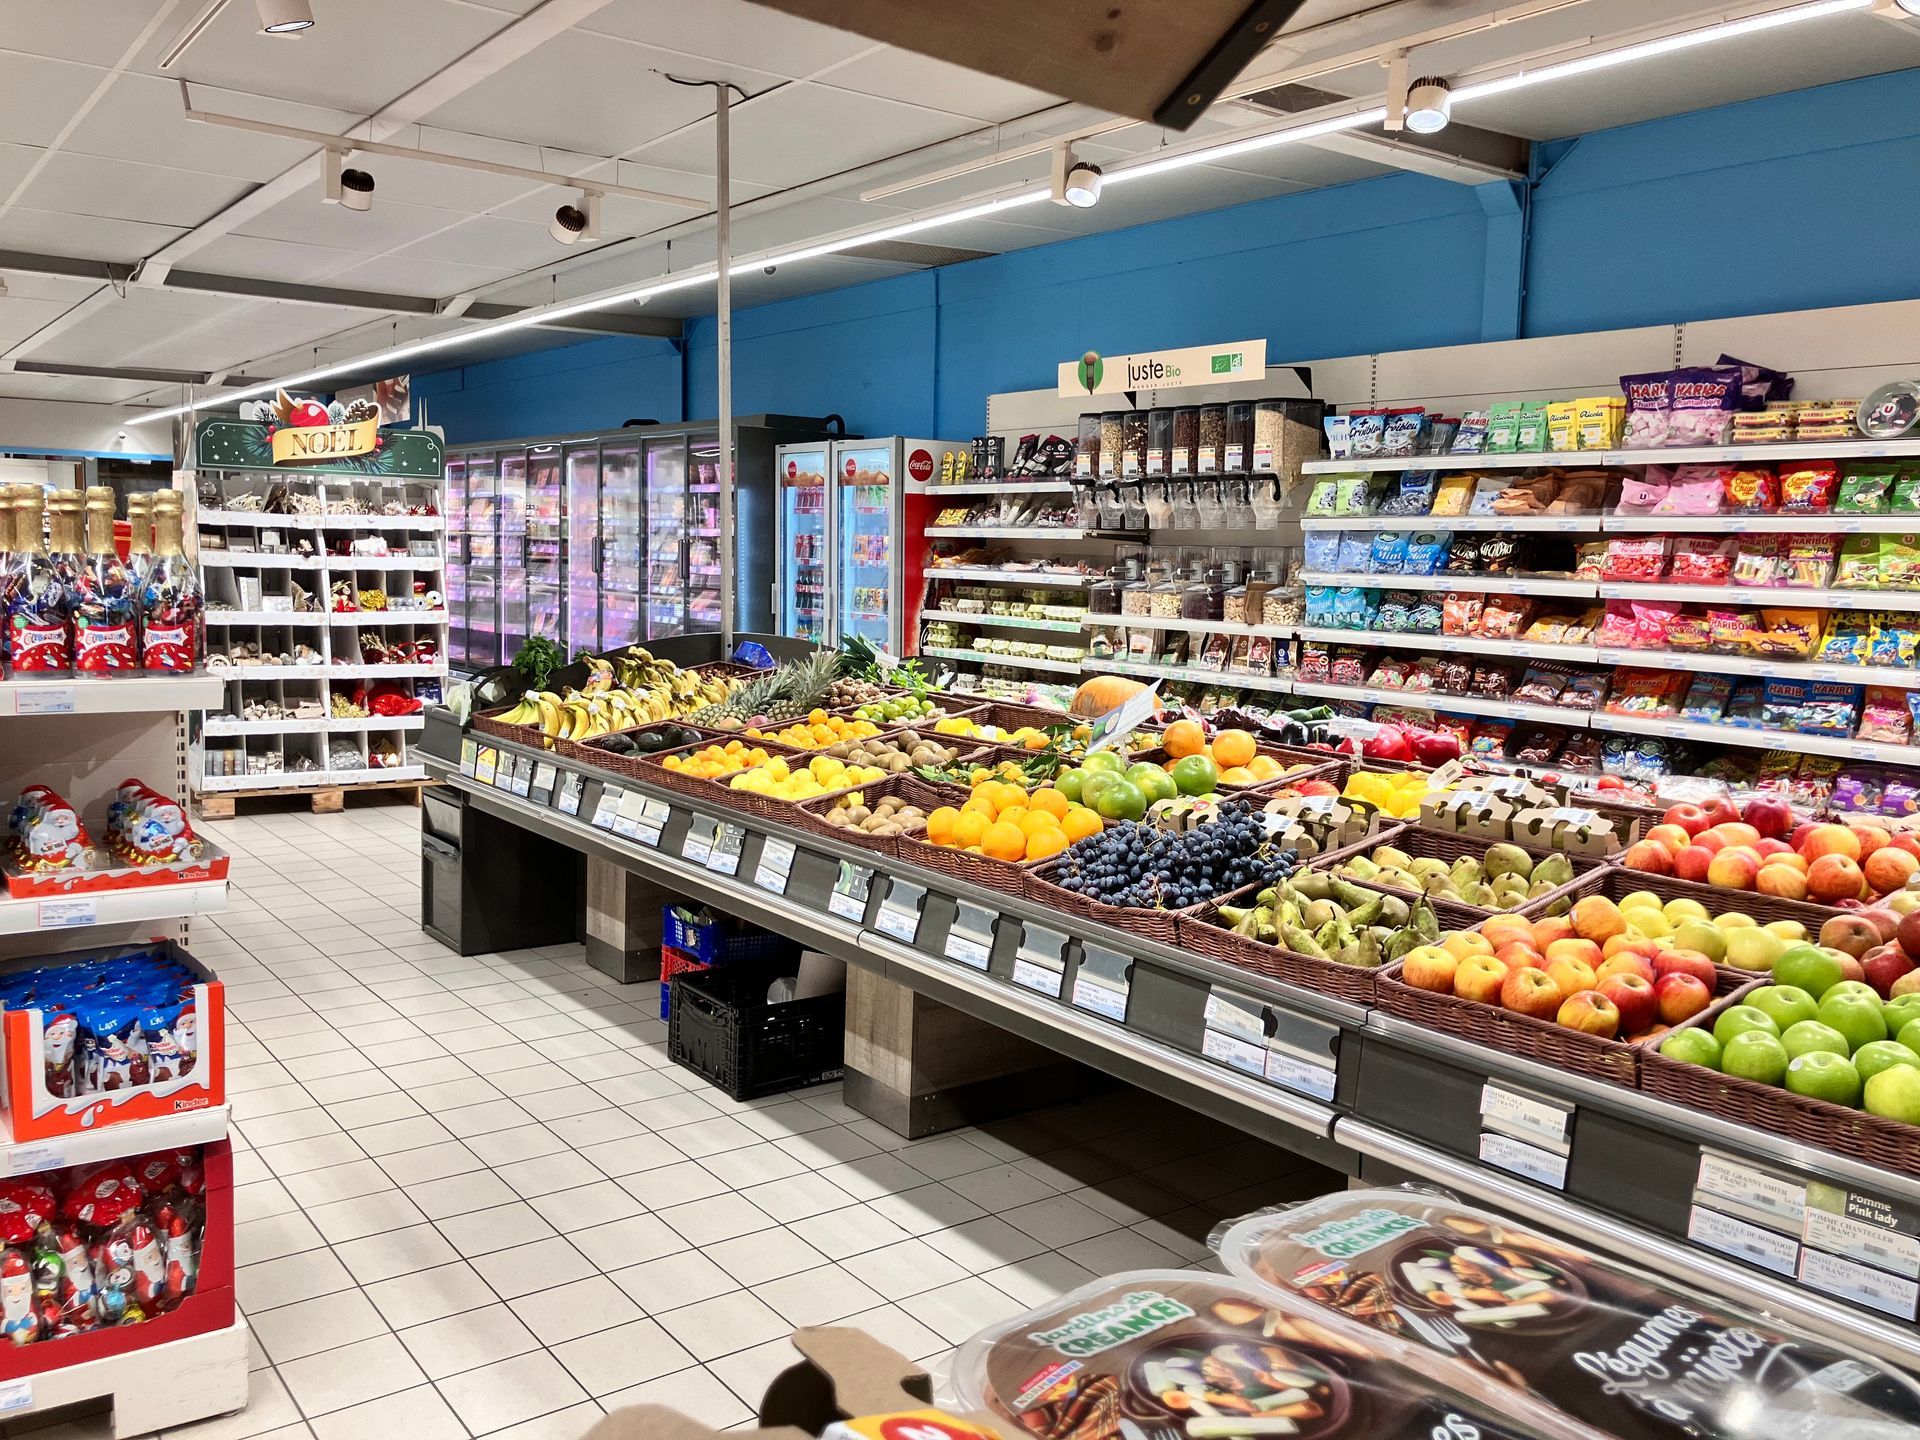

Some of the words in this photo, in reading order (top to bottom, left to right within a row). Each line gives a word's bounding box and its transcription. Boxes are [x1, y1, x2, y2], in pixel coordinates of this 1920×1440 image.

[1128, 357, 1164, 388] juste
[1165, 364, 1181, 377] Bio
[1674, 382, 1727, 397] HARIBO
[1579, 411, 1603, 419] Ricola
[290, 426, 362, 456] NOËL
[1792, 537, 1830, 546] HARIBO
[1711, 619, 1745, 630] HARIBO
[1812, 683, 1854, 694] HARIBO
[178, 871, 209, 880] Kinder
[98, 1019, 118, 1032] LAIT
[174, 1096, 209, 1110] Kinder
[1705, 1163, 1732, 1176] POMME
[1763, 1183, 1788, 1196] SMITH
[1720, 1174, 1747, 1188] FRANCE
[1849, 1193, 1892, 1212] Pomme
[1848, 1203, 1873, 1218] Pink
[1873, 1210, 1899, 1229] lady
[1809, 1211, 1837, 1226] POMME
[1839, 1221, 1894, 1245] CHANTECLER
[1826, 1224, 1856, 1239] FRANCE
[1746, 1230, 1757, 1239] DE
[1758, 1234, 1794, 1250] BOSKOOP
[1820, 1264, 1851, 1280] FRANCE
[1862, 1271, 1882, 1283] PINK
[1573, 1304, 1702, 1394] Légumes
